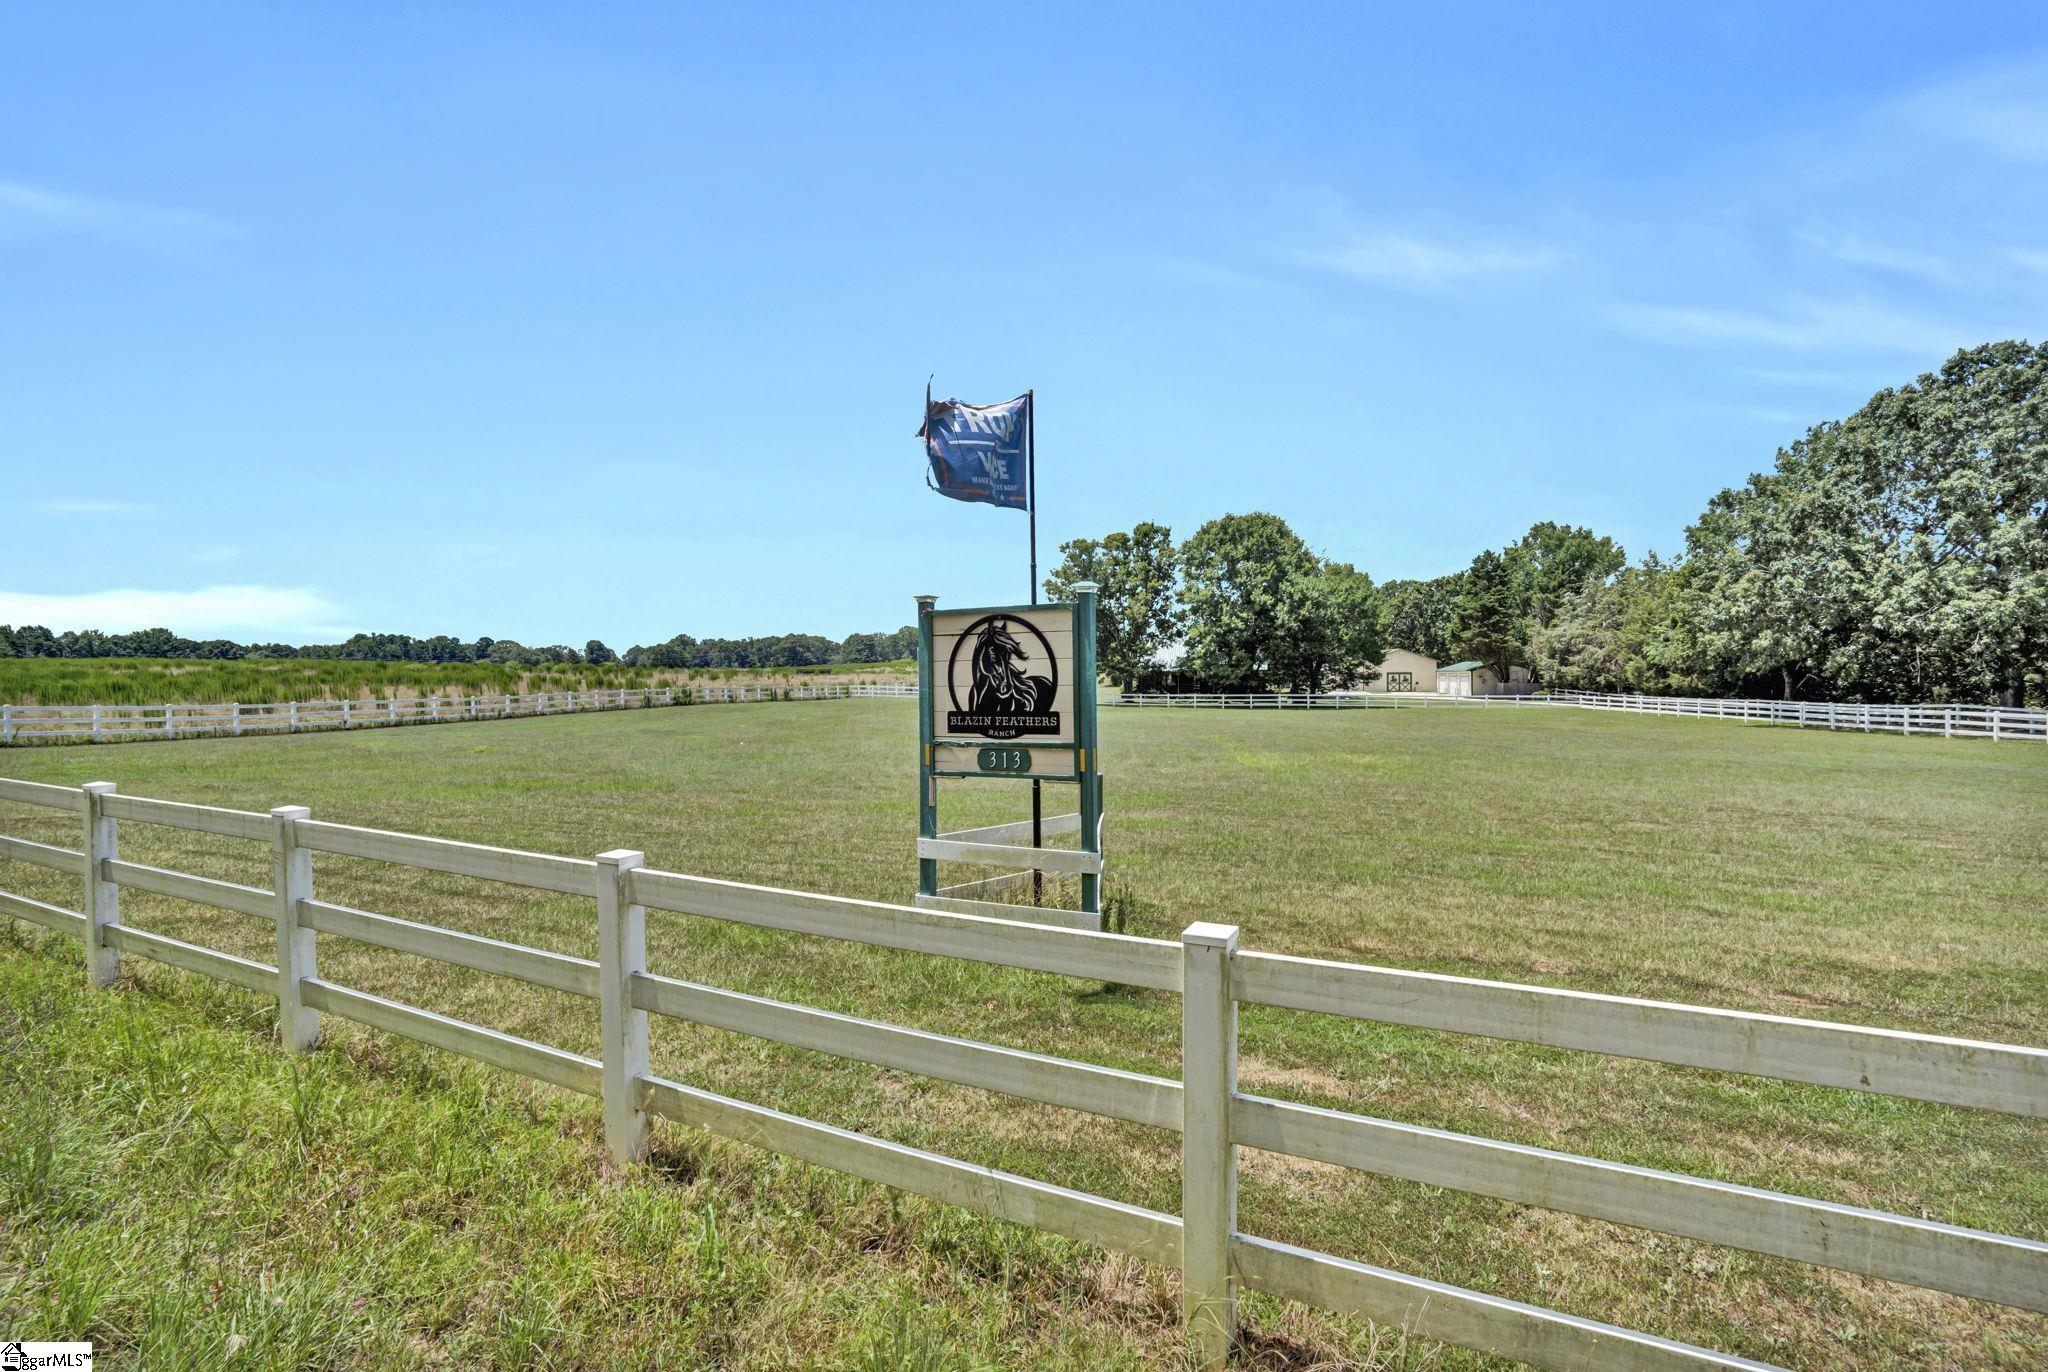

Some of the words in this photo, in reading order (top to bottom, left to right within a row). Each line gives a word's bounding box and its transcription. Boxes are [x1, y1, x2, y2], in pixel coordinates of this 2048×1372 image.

[931, 404, 1017, 442] TRUP
[950, 716, 991, 726] BLAZIN
[995, 716, 1058, 727] FEATHERS
[988, 729, 1016, 737] RANCH
[989, 751, 1021, 769] 313
